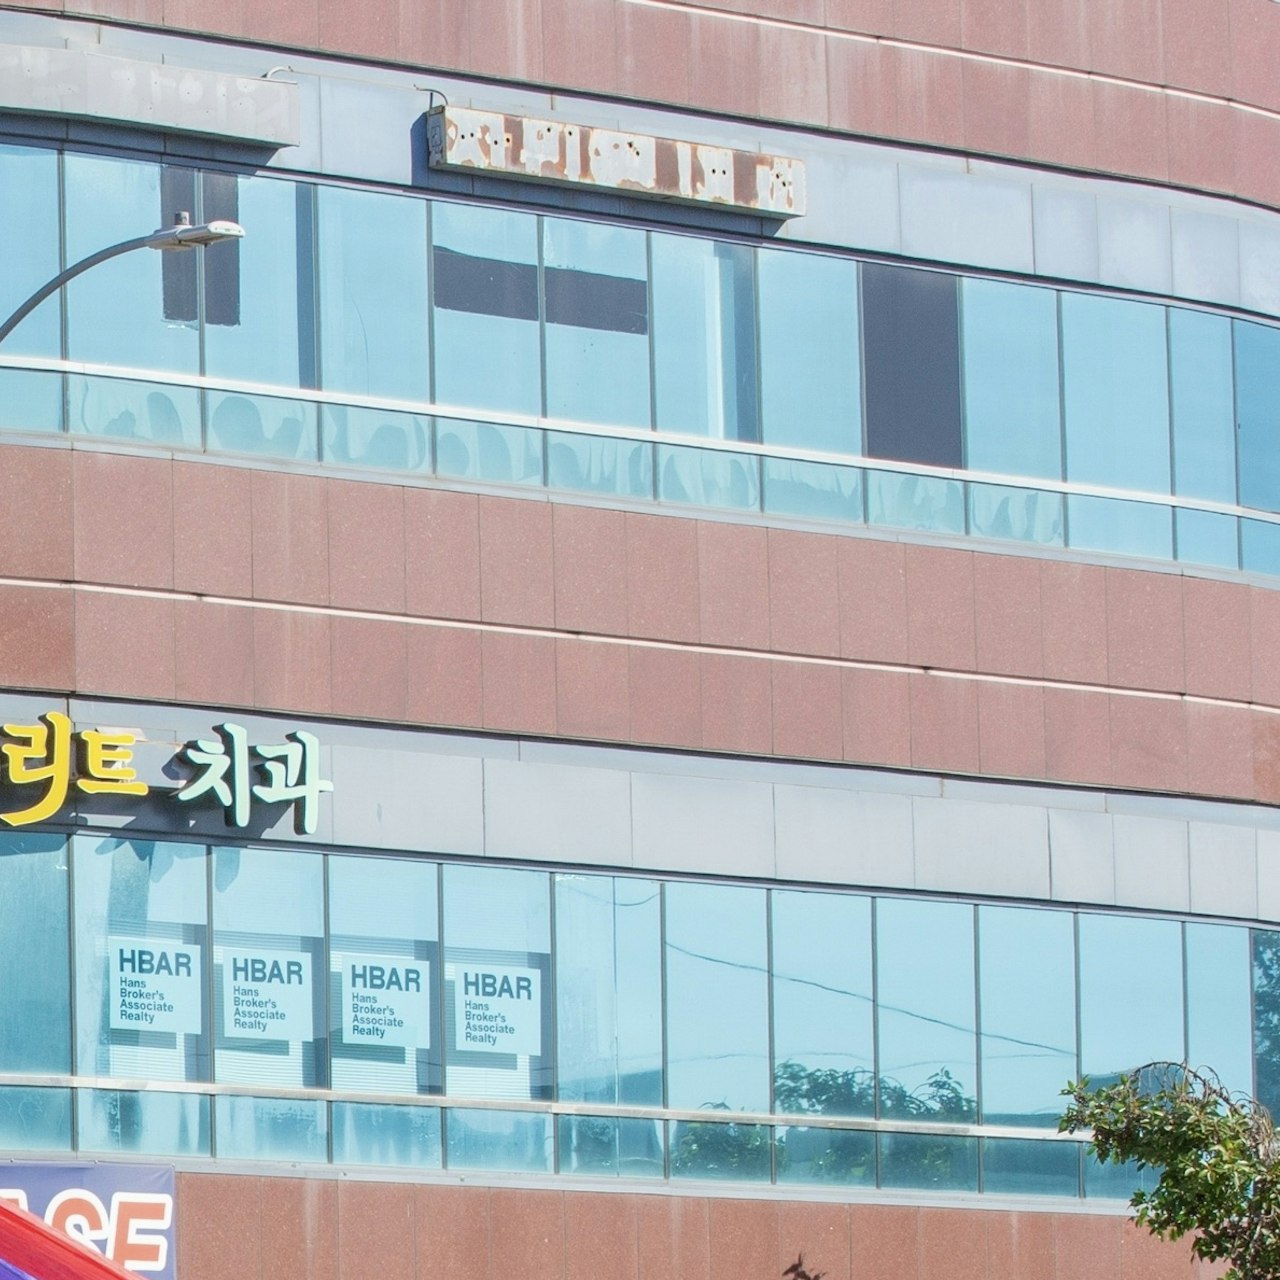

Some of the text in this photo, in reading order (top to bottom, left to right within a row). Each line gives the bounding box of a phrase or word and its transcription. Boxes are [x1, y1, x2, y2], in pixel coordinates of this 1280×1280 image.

[177, 722, 334, 835] 치과
[118, 948, 192, 977] HBAR
[232, 957, 303, 985] HBAR
[119, 977, 147, 988] Hans
[351, 964, 421, 993] HBAR
[233, 986, 259, 997] Hans
[463, 972, 532, 1000] HBAR
[119, 988, 165, 1000] Broker's
[352, 993, 378, 1004] Hans
[119, 999, 174, 1012] Associate
[233, 997, 277, 1008] Broker's
[464, 1000, 490, 1011] Hans
[233, 1008, 286, 1020] Associate
[352, 1004, 395, 1016] Broker's
[120, 1010, 155, 1024] Realty
[352, 1015, 404, 1027] Associate
[465, 1011, 506, 1022] Broker's
[234, 1018, 268, 1032] Realty
[465, 1022, 516, 1034] Associate
[352, 1025, 385, 1039] Realty
[465, 1032, 497, 1046] Realty
